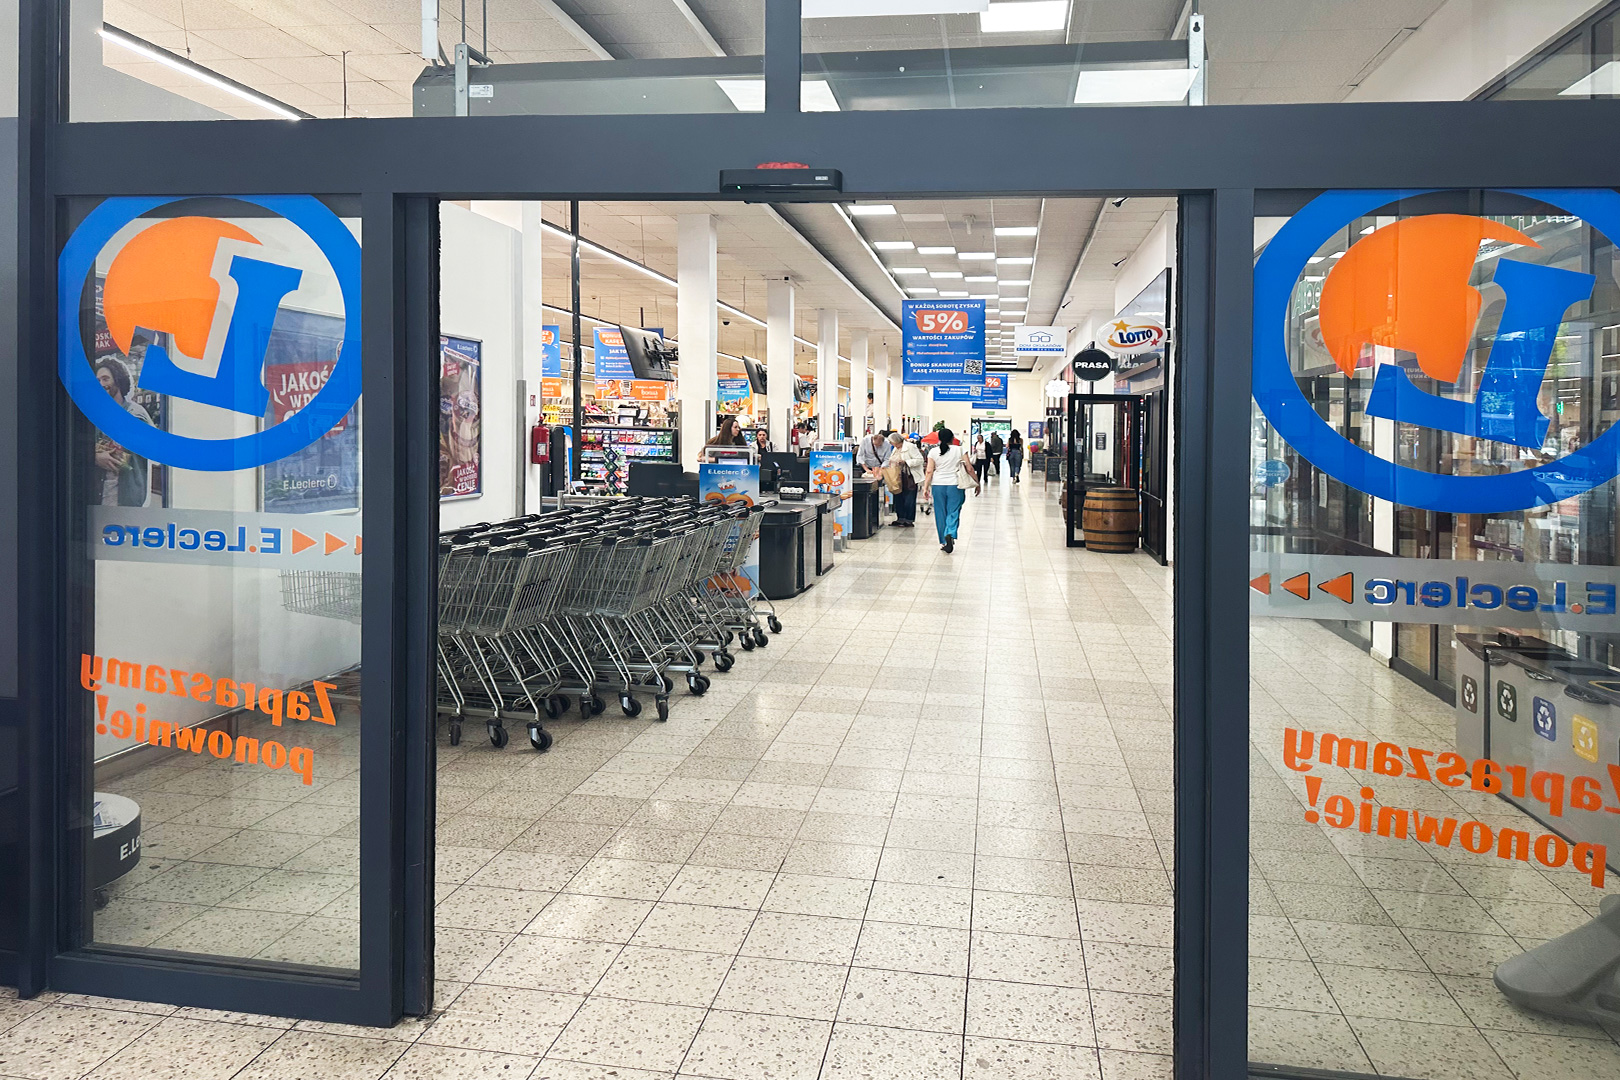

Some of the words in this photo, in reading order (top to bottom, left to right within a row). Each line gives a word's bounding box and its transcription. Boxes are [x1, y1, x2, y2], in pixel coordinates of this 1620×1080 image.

[922, 311, 963, 333] 5%
[1119, 329, 1153, 344] LOTTO
[1075, 361, 1110, 369] PRASA
[280, 364, 335, 396] JAKOŚ
[283, 478, 326, 490] E.Leclerc
[812, 469, 846, 487] 30
